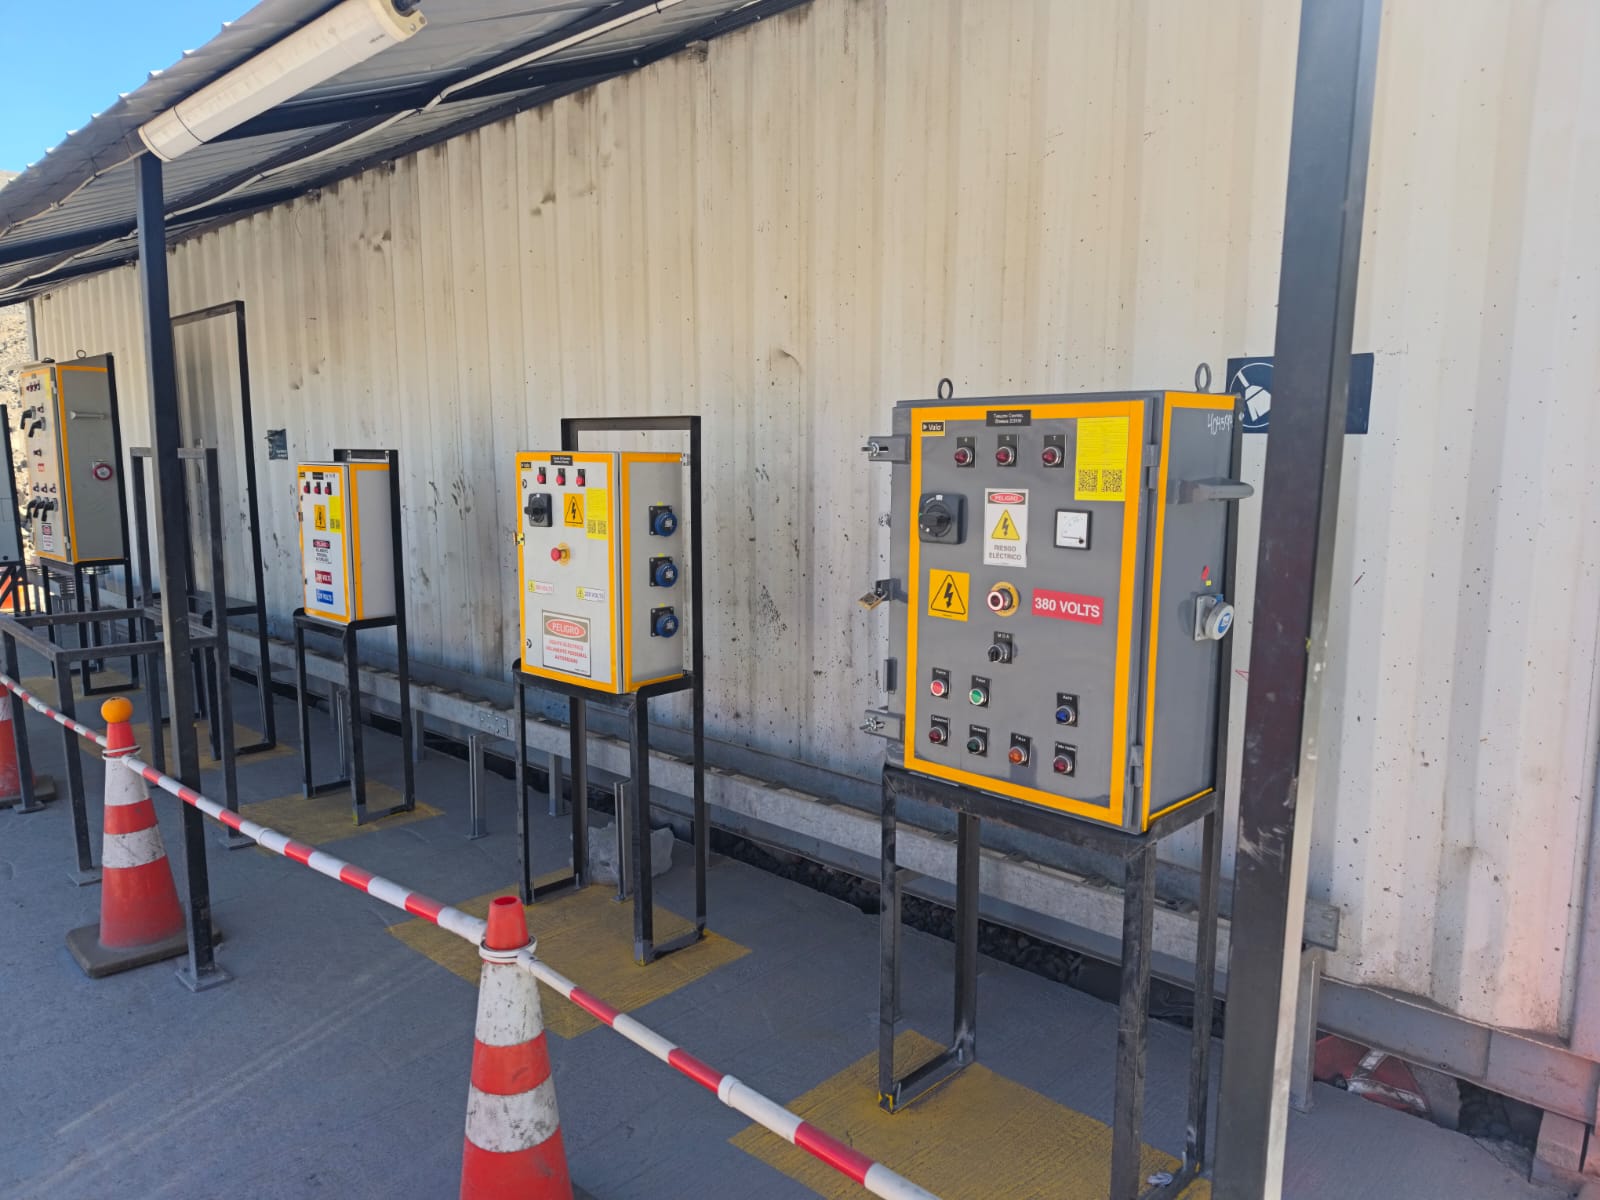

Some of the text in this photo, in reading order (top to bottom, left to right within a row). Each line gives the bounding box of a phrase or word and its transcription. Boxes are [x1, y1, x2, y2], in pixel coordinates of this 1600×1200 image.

[1034, 597, 1100, 618] 380 VOLTS
[552, 622, 580, 635] PELIGRO
